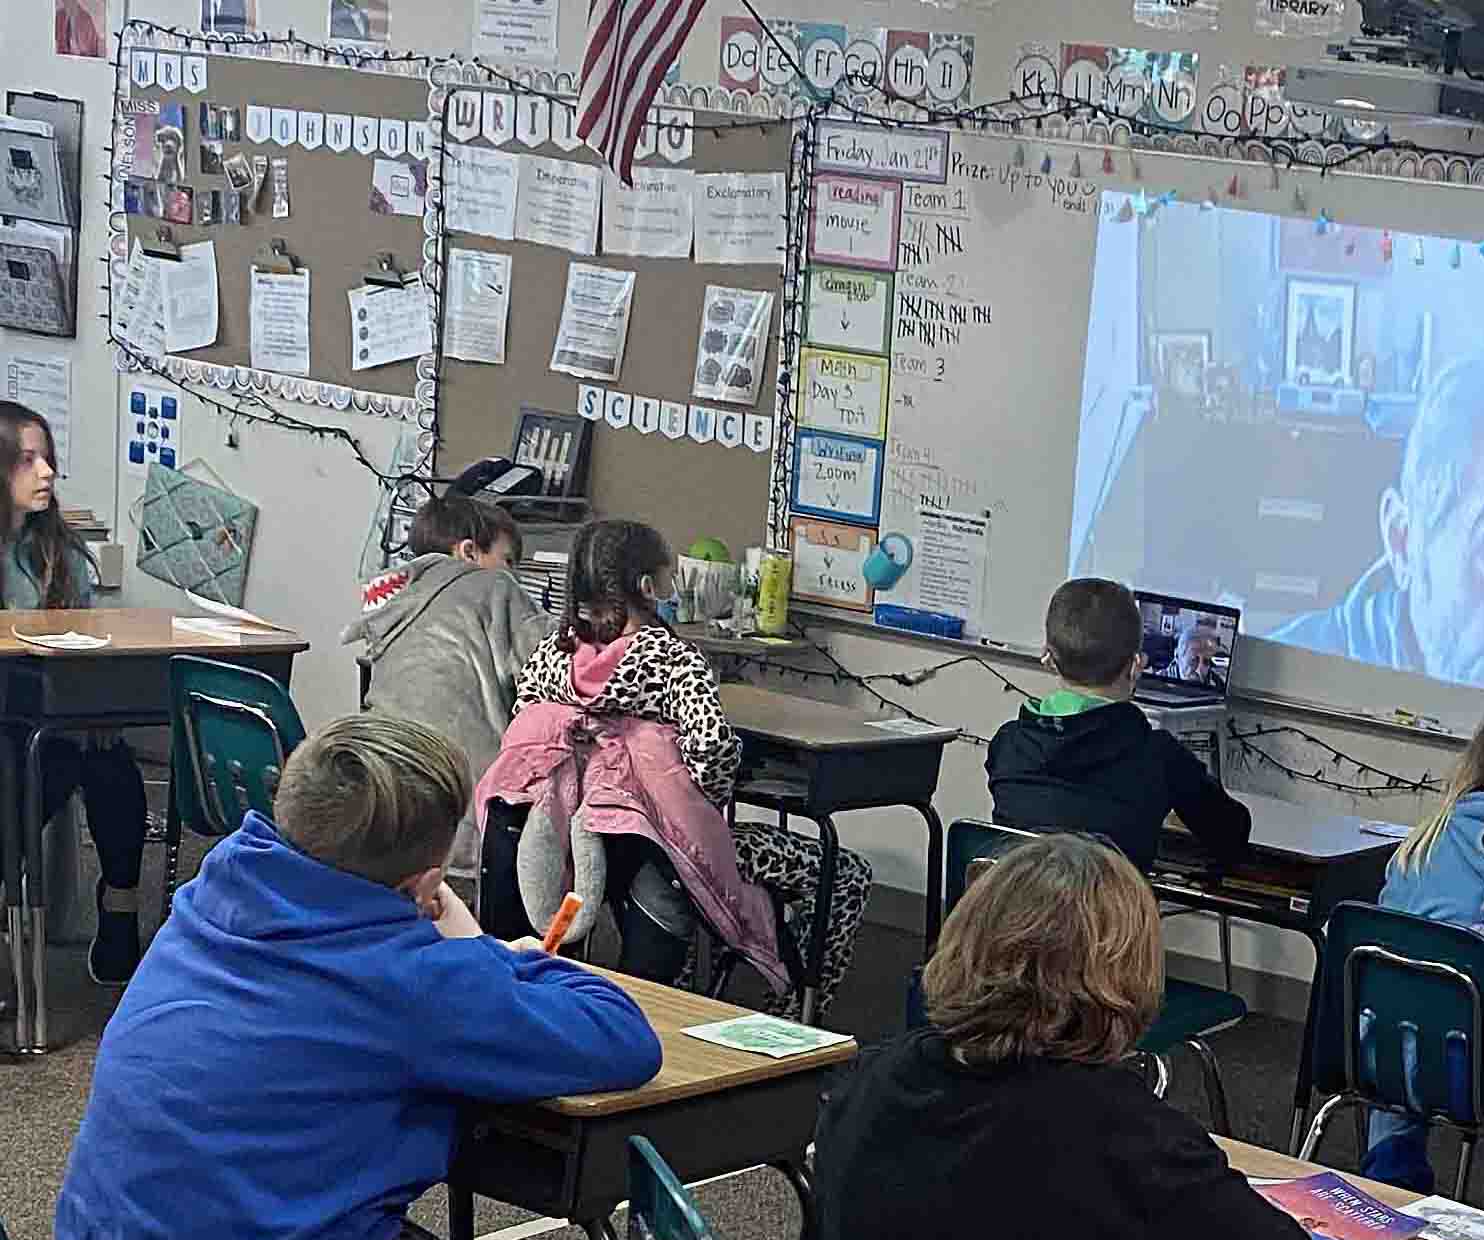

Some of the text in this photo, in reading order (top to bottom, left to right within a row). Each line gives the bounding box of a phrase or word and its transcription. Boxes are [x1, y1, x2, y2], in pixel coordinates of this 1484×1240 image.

[136, 55, 200, 86] MRS
[728, 43, 757, 68] Dd
[894, 57, 924, 86] Hh
[1158, 80, 1191, 110] Nn
[1206, 95, 1242, 132] Oo
[1250, 96, 1285, 133] Pp
[254, 112, 427, 152] JOHNSON
[826, 134, 875, 167] Friday
[905, 185, 948, 210] Team
[583, 390, 764, 446] SCIENCE
